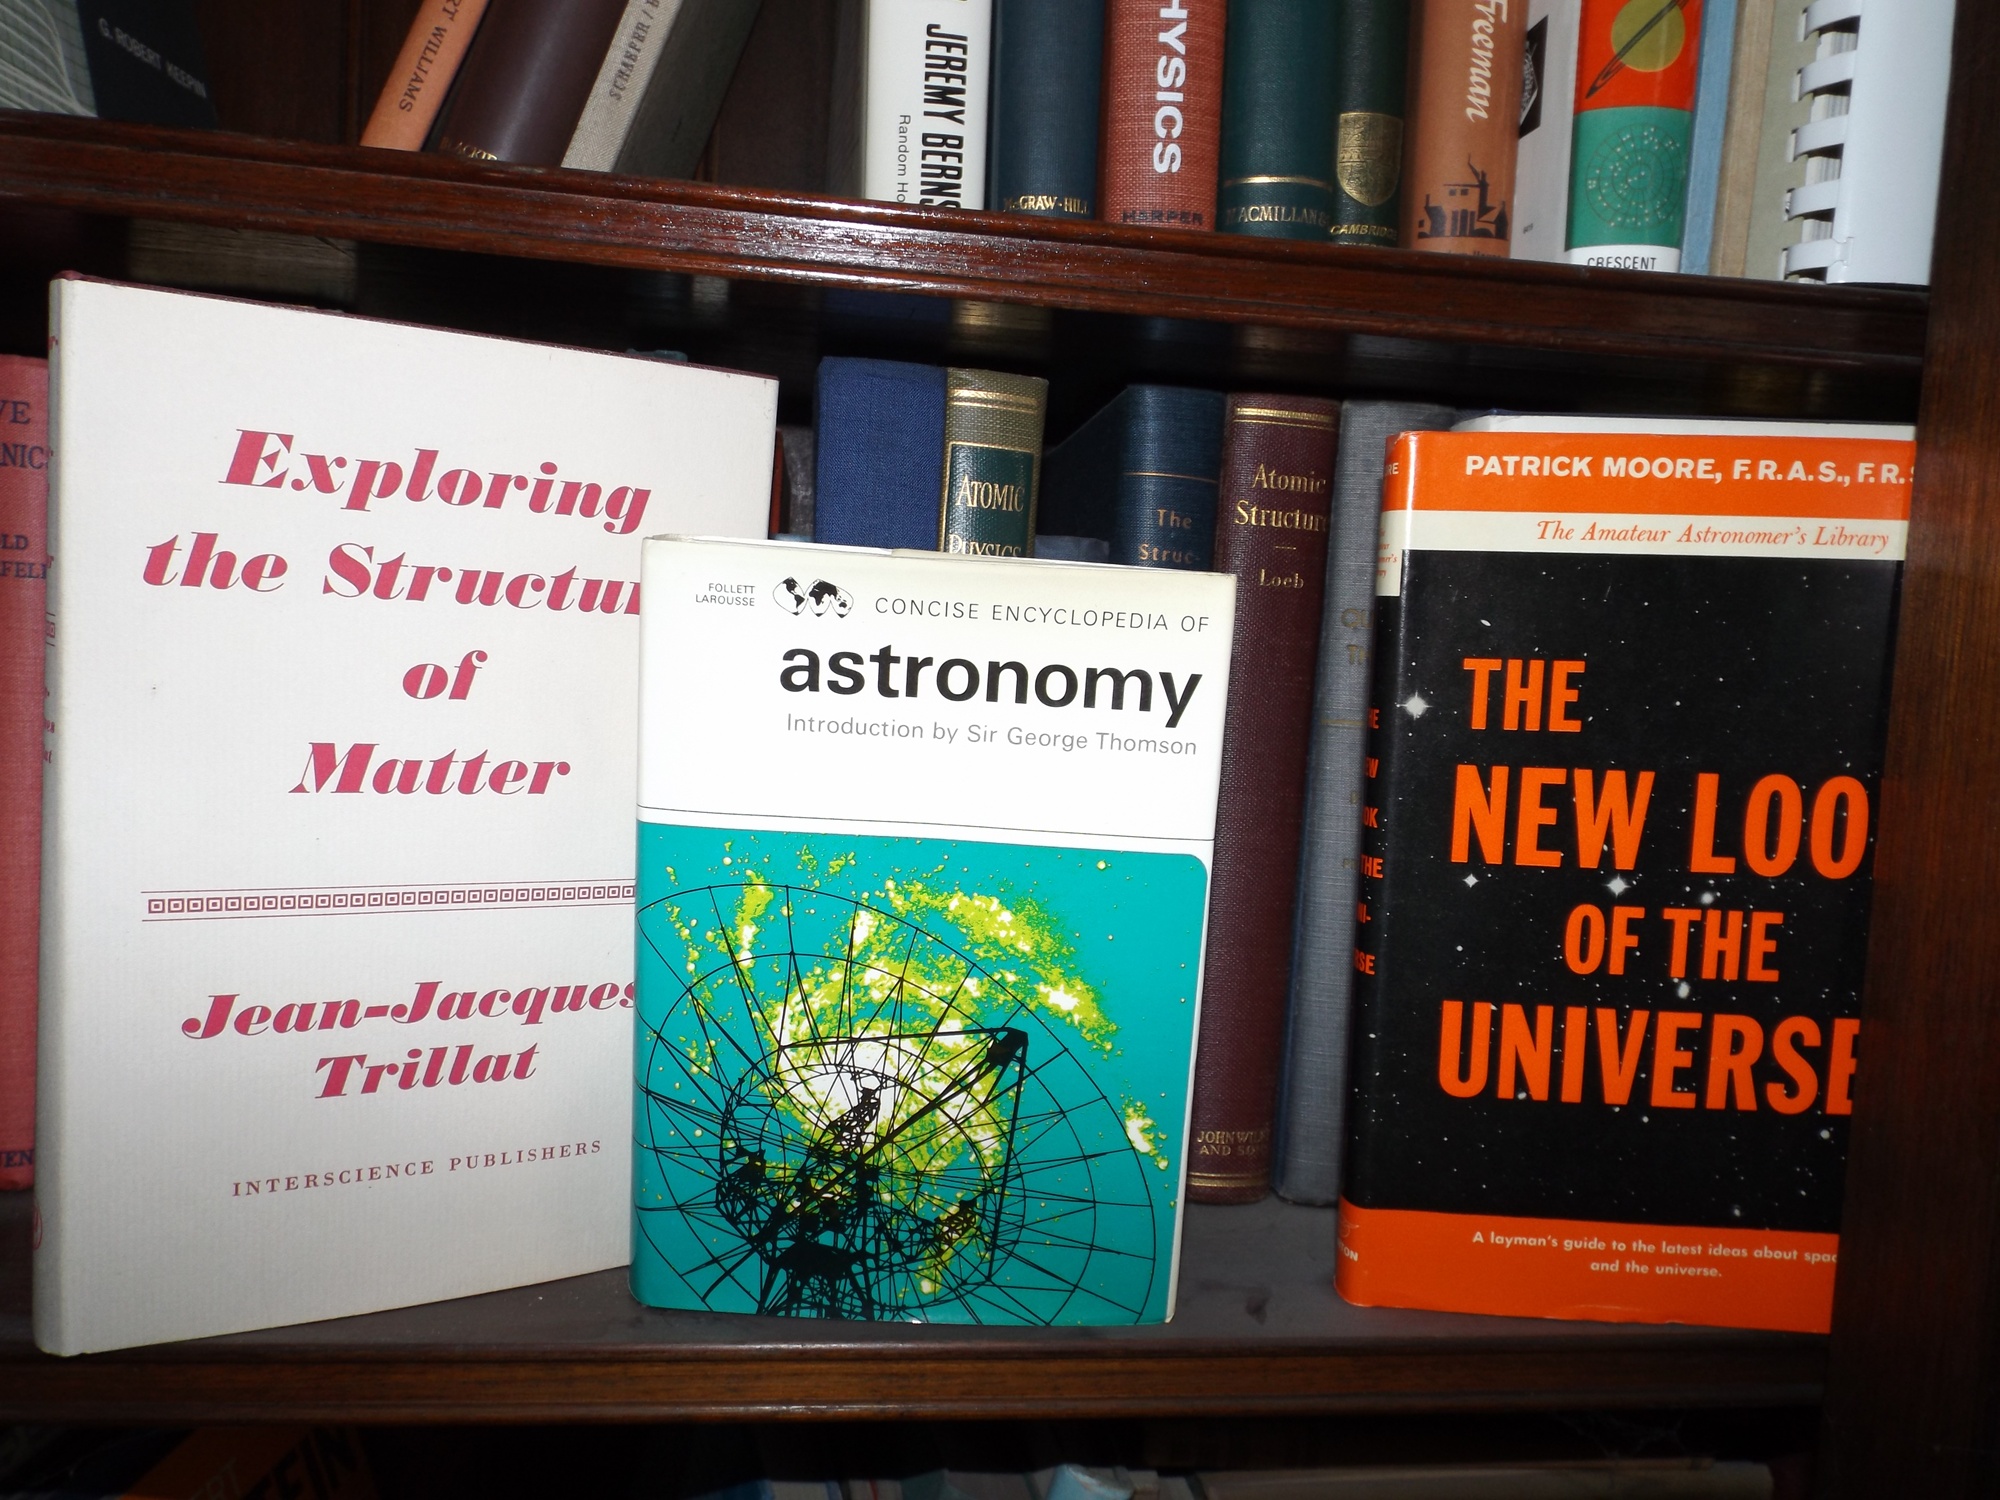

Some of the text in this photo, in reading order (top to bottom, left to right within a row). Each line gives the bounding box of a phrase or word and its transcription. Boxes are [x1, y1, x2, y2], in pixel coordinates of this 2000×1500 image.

[399, 26, 447, 112] WILLIAMS
[1466, 0, 1508, 122] Freeman
[1152, 0, 1188, 174] HYSICS
[919, 23, 968, 209] JEREMY BERNS
[896, 114, 911, 203] Random Ho
[1121, 210, 1204, 226] HARPER
[1330, 223, 1398, 241] CAMBRIDGE
[1587, 256, 1657, 271] CRESCENT
[218, 428, 653, 534] Exploring
[1252, 463, 1327, 494] Atomic
[1465, 455, 1592, 478] PATRICK
[1603, 457, 1723, 484] MOORE,
[1858, 462, 1914, 485] F.R.
[954, 473, 1026, 512] ATOMIC
[1157, 508, 1193, 530] The
[1536, 520, 1890, 555] The Amateur Astronomer's Library
[142, 532, 288, 592] the
[1259, 568, 1305, 589] Loeb
[695, 593, 756, 607] LAROUSSE
[708, 583, 756, 595] FOLLETT
[875, 596, 1210, 633] CONCISE ENCYCLOPEDIA OF
[402, 649, 488, 700] of
[779, 644, 1203, 729] astronomy
[1463, 658, 1586, 732] THE
[787, 712, 1198, 756] Introduction by Sir George Thomson
[288, 742, 571, 795] Matter
[1450, 764, 1870, 880] NEW LOO
[1564, 904, 1784, 982] OF THE
[314, 1042, 540, 1099] Trillat
[1438, 1000, 1861, 1116] UNIVERSE
[1196, 1130, 1234, 1145] JOHN
[1199, 1144, 1232, 1157] AND
[0, 1149, 34, 1168] EN
[232, 1140, 603, 1198] INTERSCIENCE PUBLISHERS
[1472, 1231, 1484, 1244] A
[1490, 1231, 1558, 1250] layman's
[1563, 1237, 1606, 1252] guide
[1611, 1240, 1627, 1252] to
[1632, 1240, 1656, 1254] the
[1661, 1241, 1704, 1256] latest
[1707, 1242, 1749, 1258] ideas
[1753, 1245, 1798, 1261] about
[1590, 1260, 1723, 1278] and the universe.
